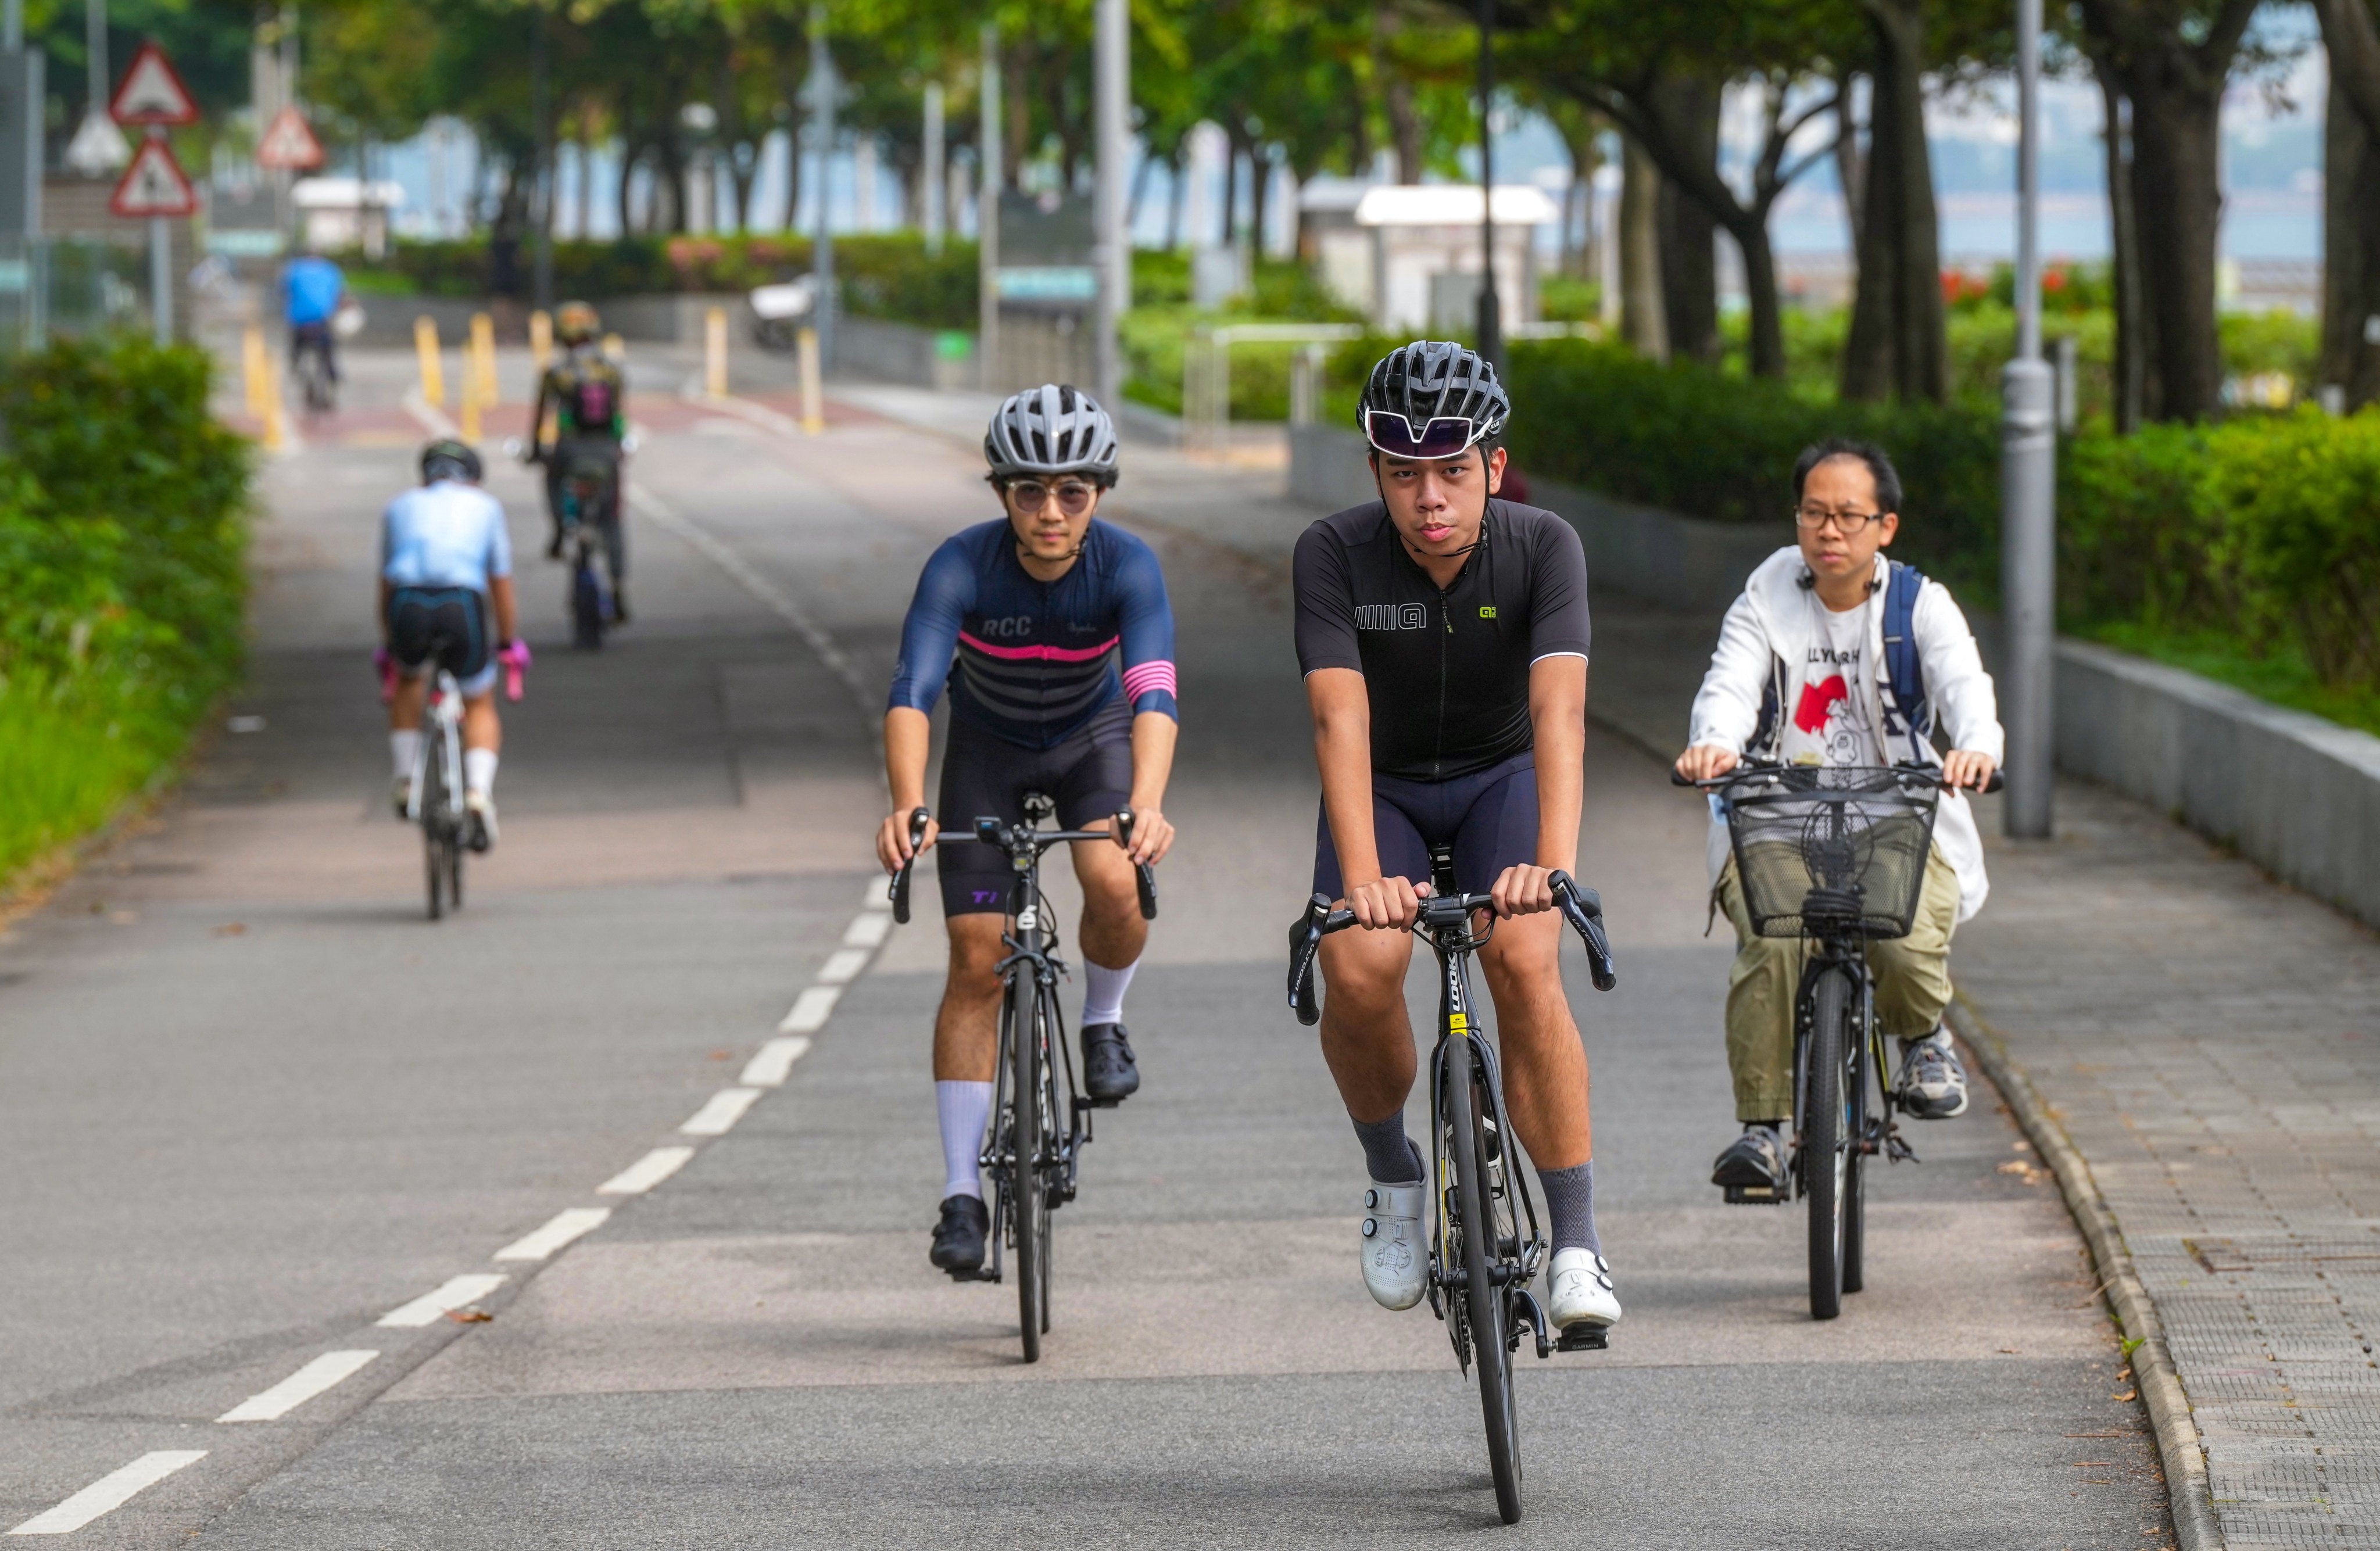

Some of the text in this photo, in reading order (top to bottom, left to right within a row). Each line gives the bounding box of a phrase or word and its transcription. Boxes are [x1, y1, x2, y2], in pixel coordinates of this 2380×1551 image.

[981, 615, 1032, 637] RCC
[1571, 918, 1604, 959] ULTEGRA
[1295, 943, 1315, 991] ULTEGRA
[1448, 952, 1461, 1012] LOOK
[1529, 1245, 1541, 1268] OOK
